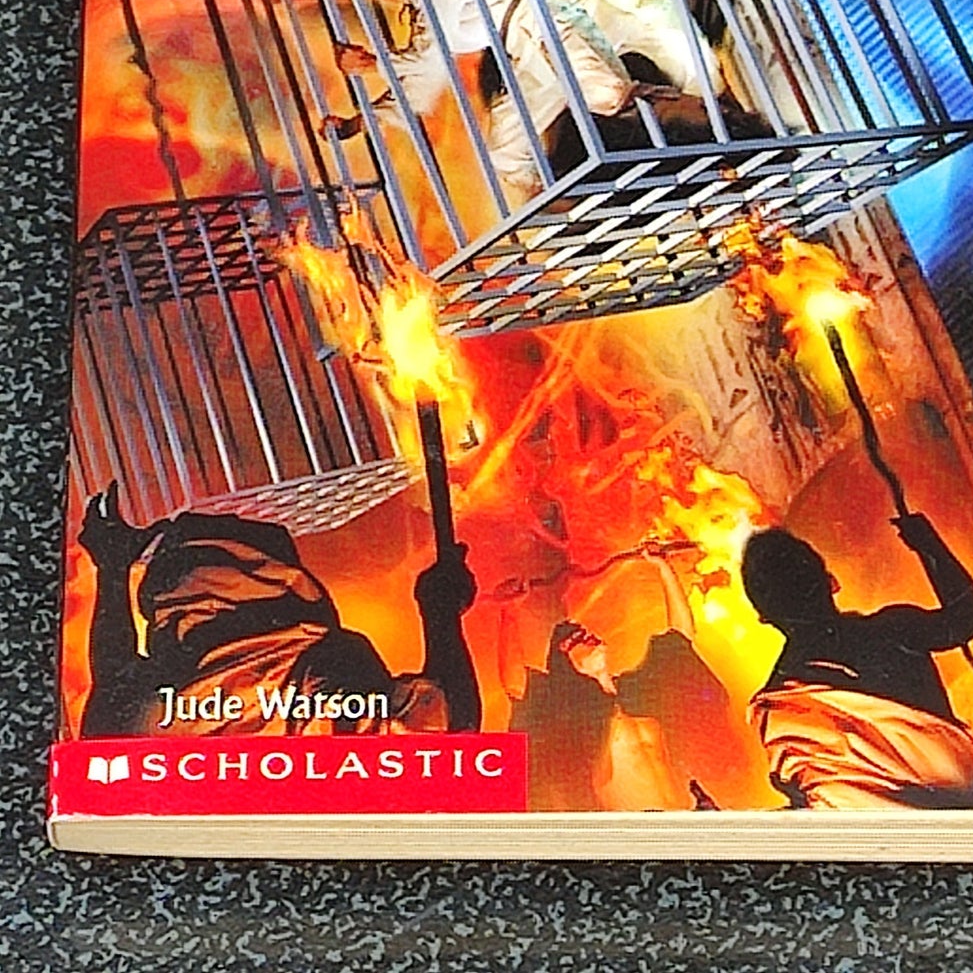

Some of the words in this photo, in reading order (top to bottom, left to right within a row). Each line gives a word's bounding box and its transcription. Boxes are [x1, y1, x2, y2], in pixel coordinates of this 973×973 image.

[157, 687, 243, 727] Jude
[257, 688, 390, 721] Watson
[140, 749, 504, 782] SCHOLASTIC
